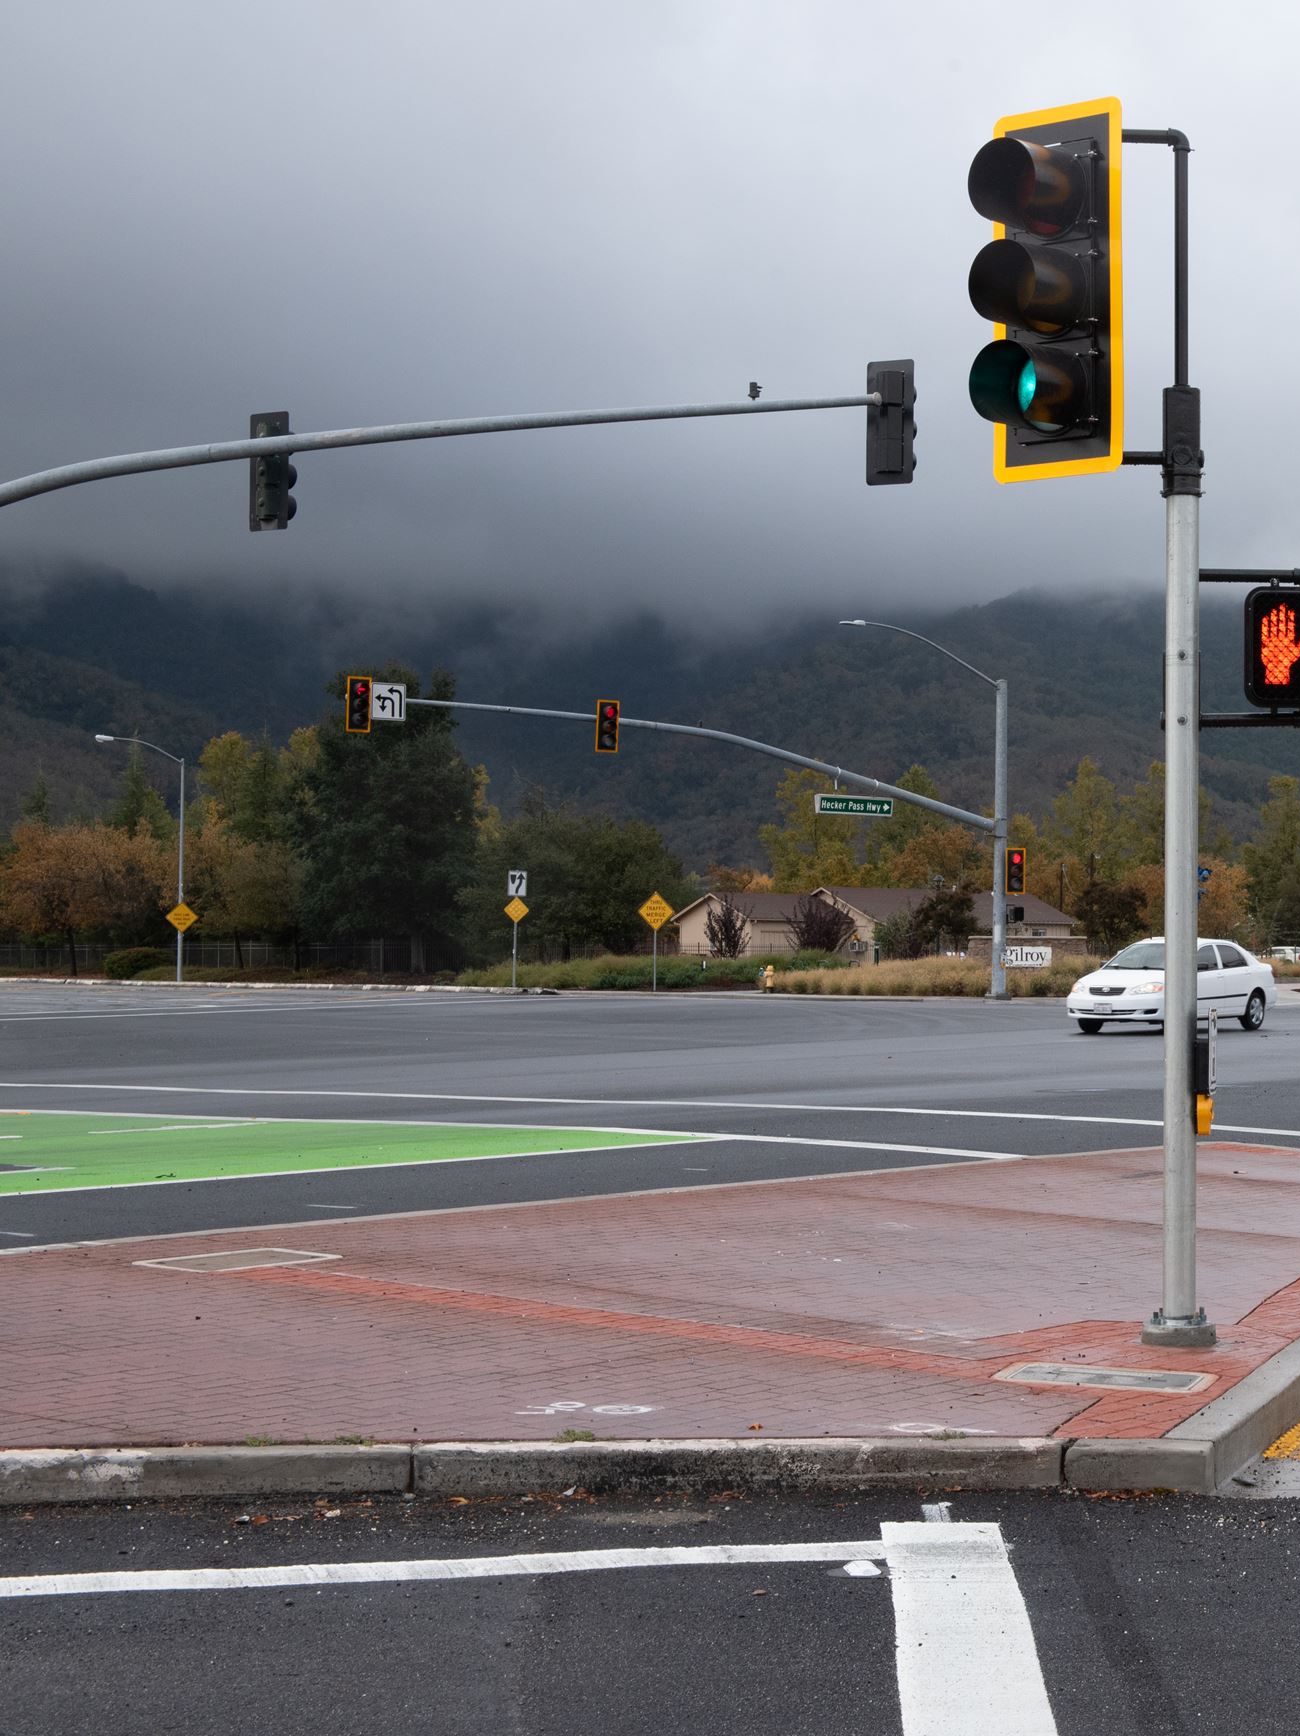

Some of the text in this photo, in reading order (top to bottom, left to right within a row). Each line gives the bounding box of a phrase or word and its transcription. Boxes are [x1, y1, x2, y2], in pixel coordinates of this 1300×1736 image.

[821, 799, 882, 813] Hecker Pass Hwy
